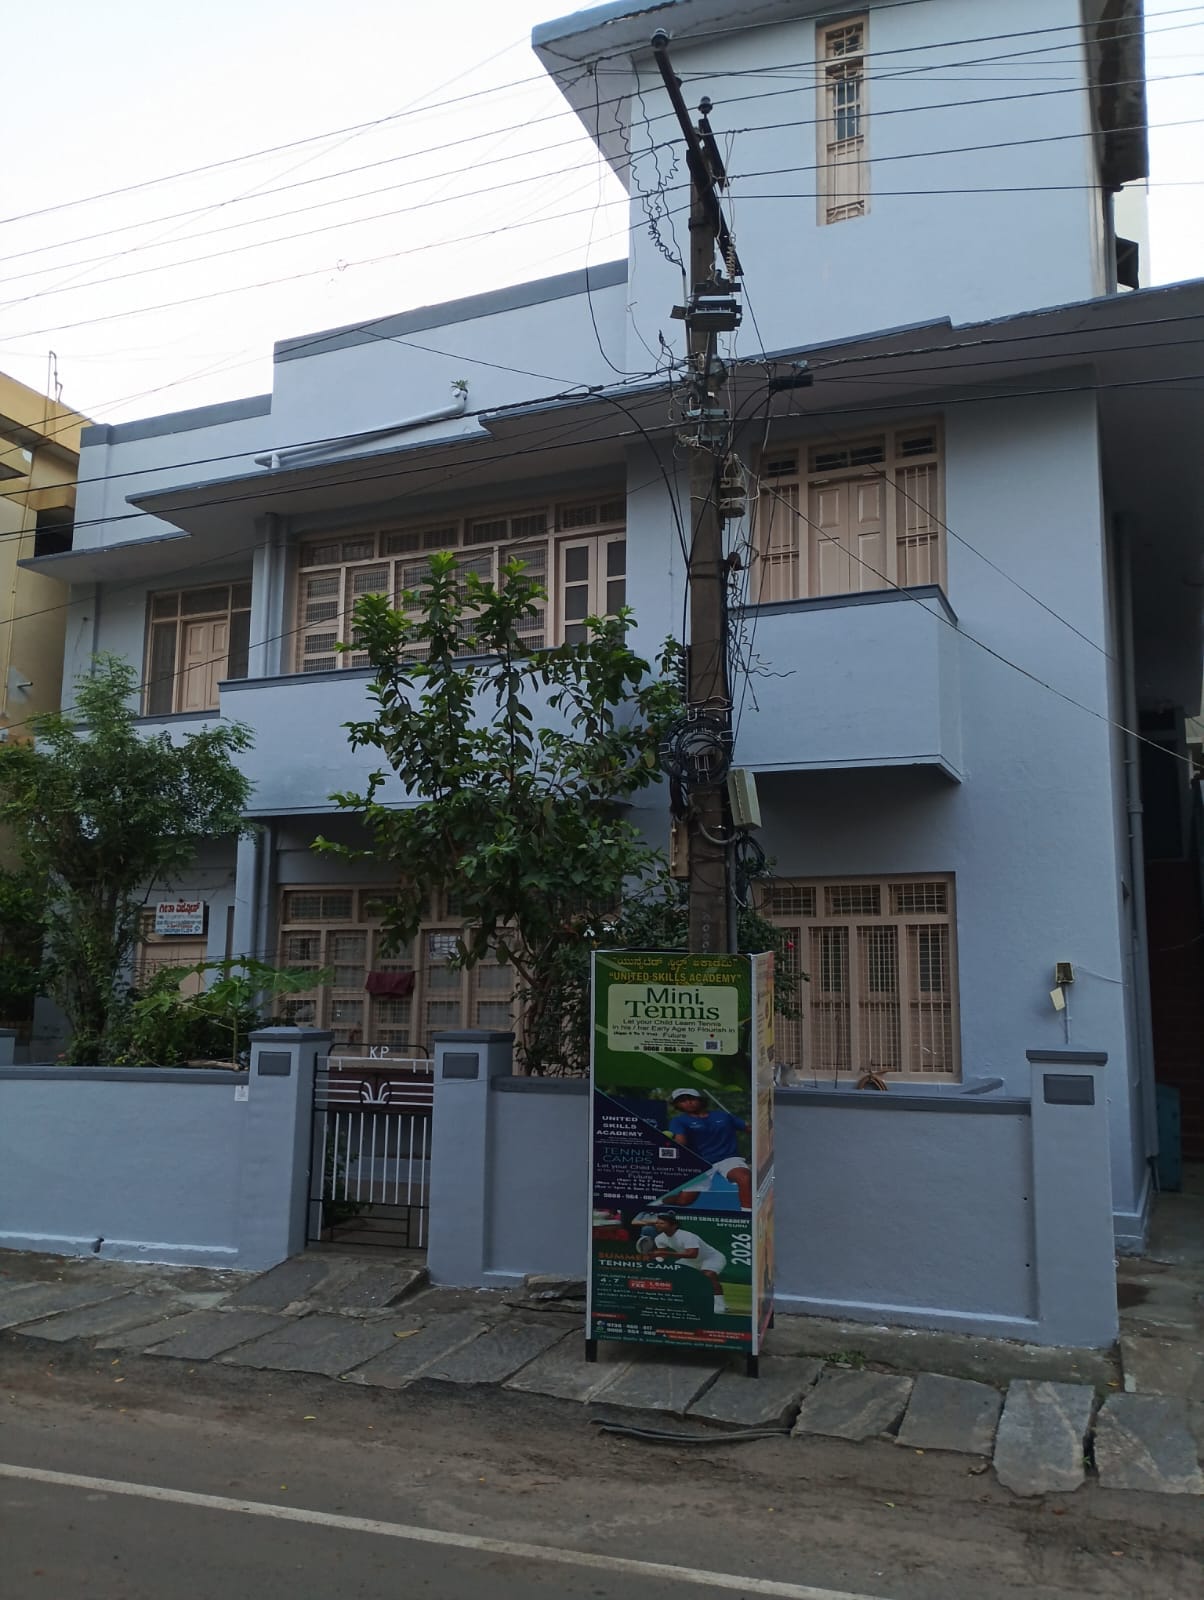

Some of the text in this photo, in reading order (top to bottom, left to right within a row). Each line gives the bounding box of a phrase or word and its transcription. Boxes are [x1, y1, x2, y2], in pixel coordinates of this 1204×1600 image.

[650, 973, 686, 983] SKILLS
[647, 988, 700, 1005] Mini
[625, 1000, 720, 1020] Tennis
[651, 1026, 669, 1034] Early
[603, 1147, 655, 1156] TENNIS
[602, 1155, 654, 1164] CAMPS
[731, 1233, 752, 1266] 2026
[597, 1252, 651, 1262] SUMMER
[599, 1259, 643, 1268] TENNIS
[646, 1262, 682, 1271] CAMP
